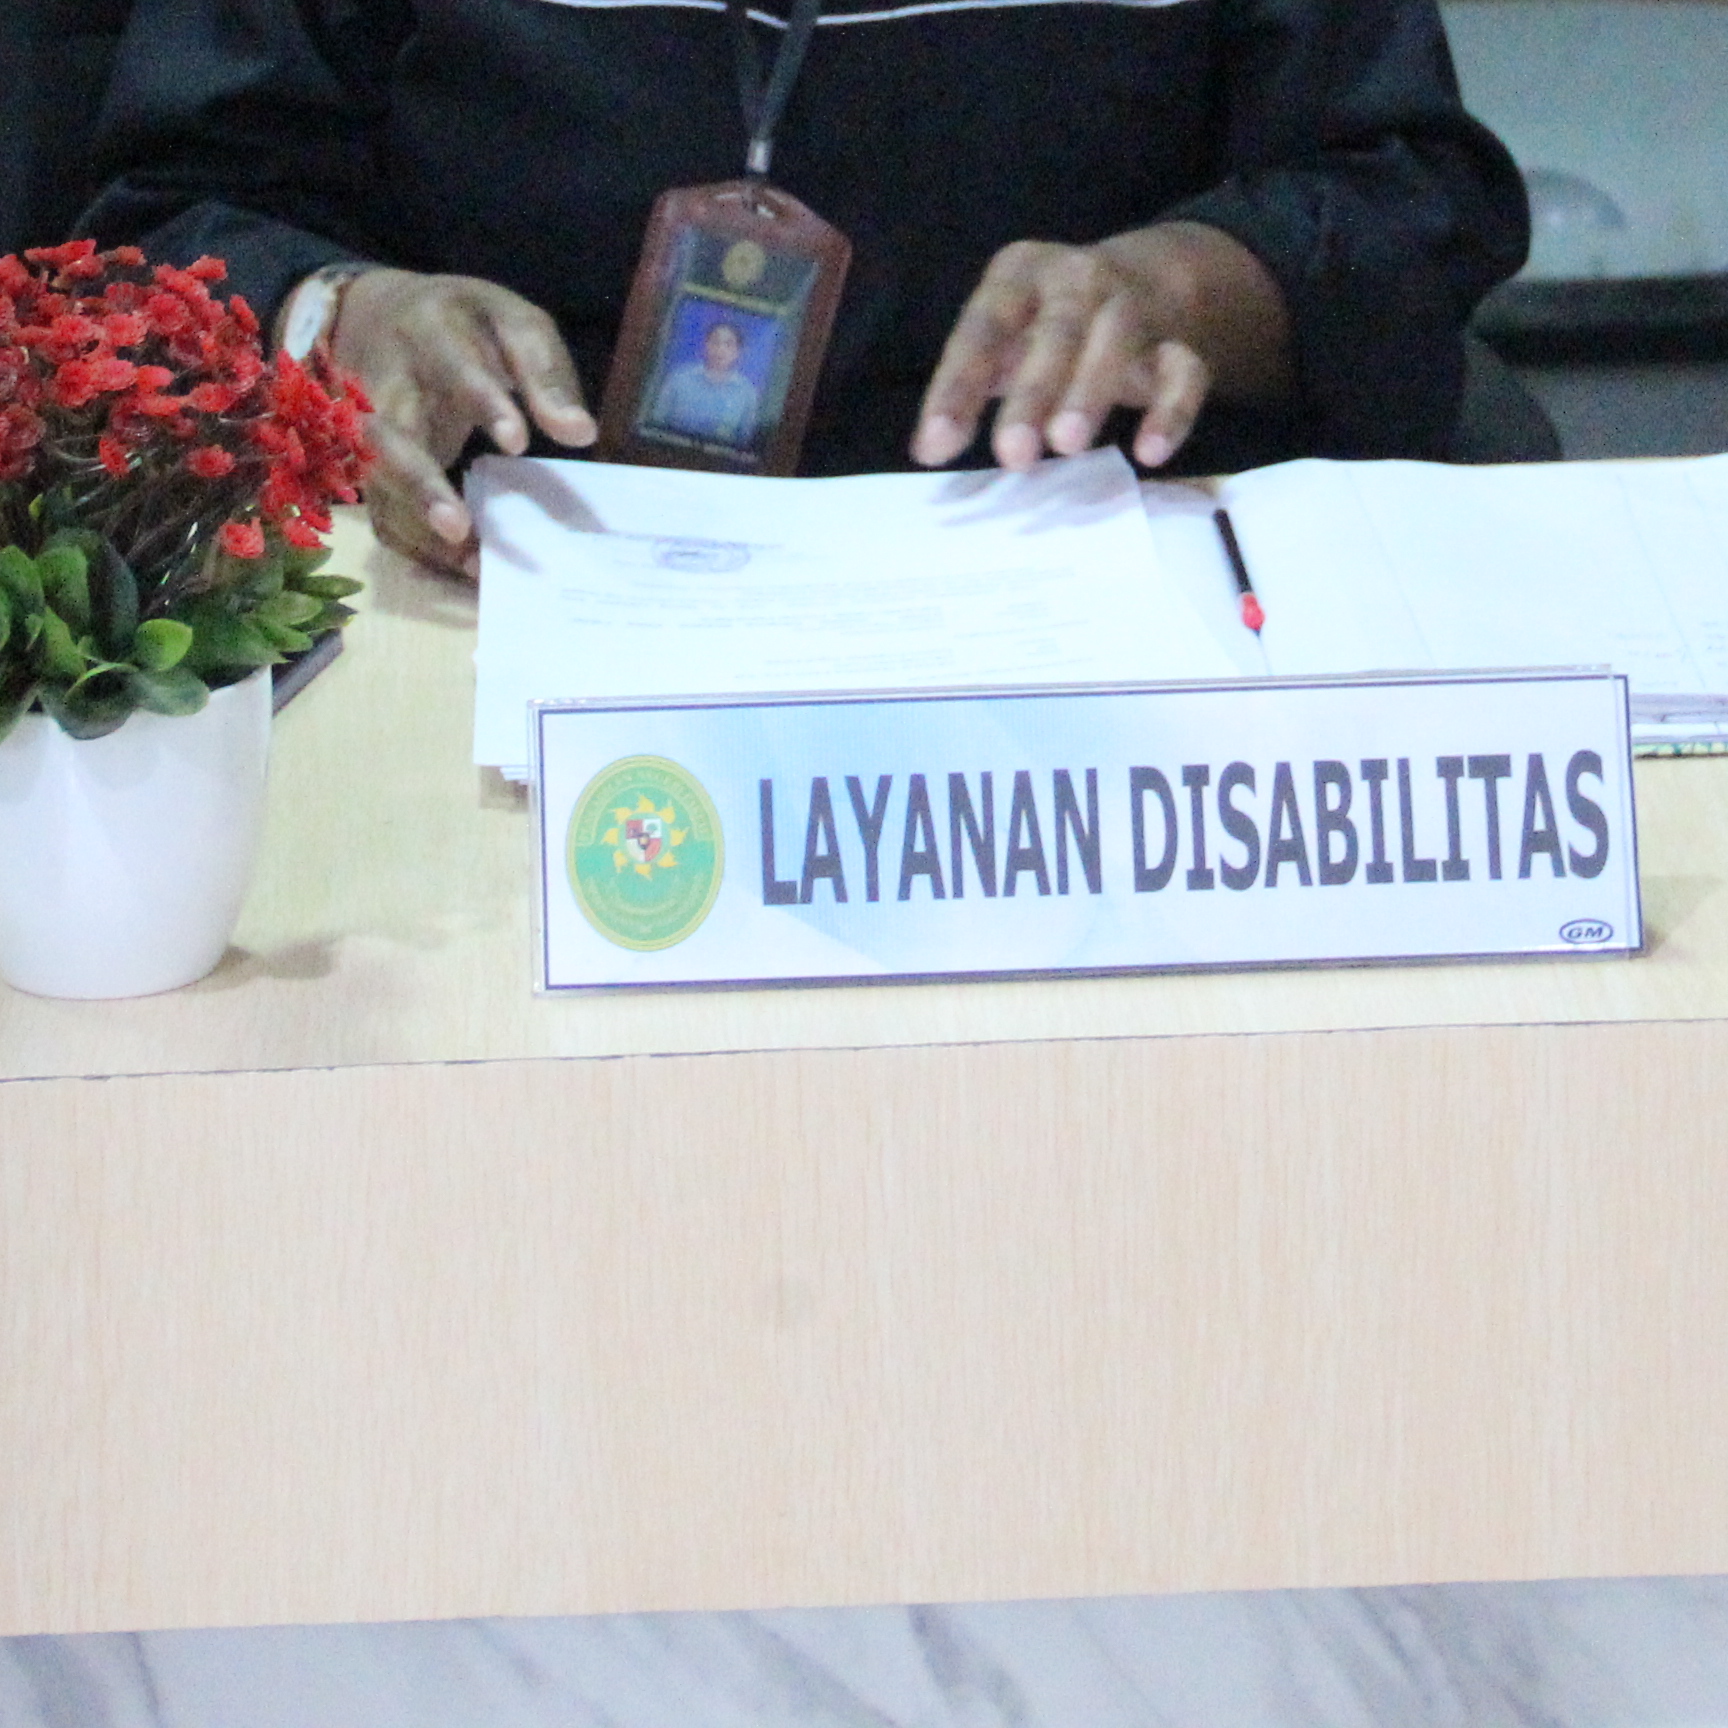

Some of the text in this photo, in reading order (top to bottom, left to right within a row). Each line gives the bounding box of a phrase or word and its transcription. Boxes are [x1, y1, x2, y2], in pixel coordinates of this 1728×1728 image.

[757, 766, 1104, 908] LAYANAN
[1128, 748, 1611, 895] DISABILITAS
[1566, 926, 1604, 940] GM
